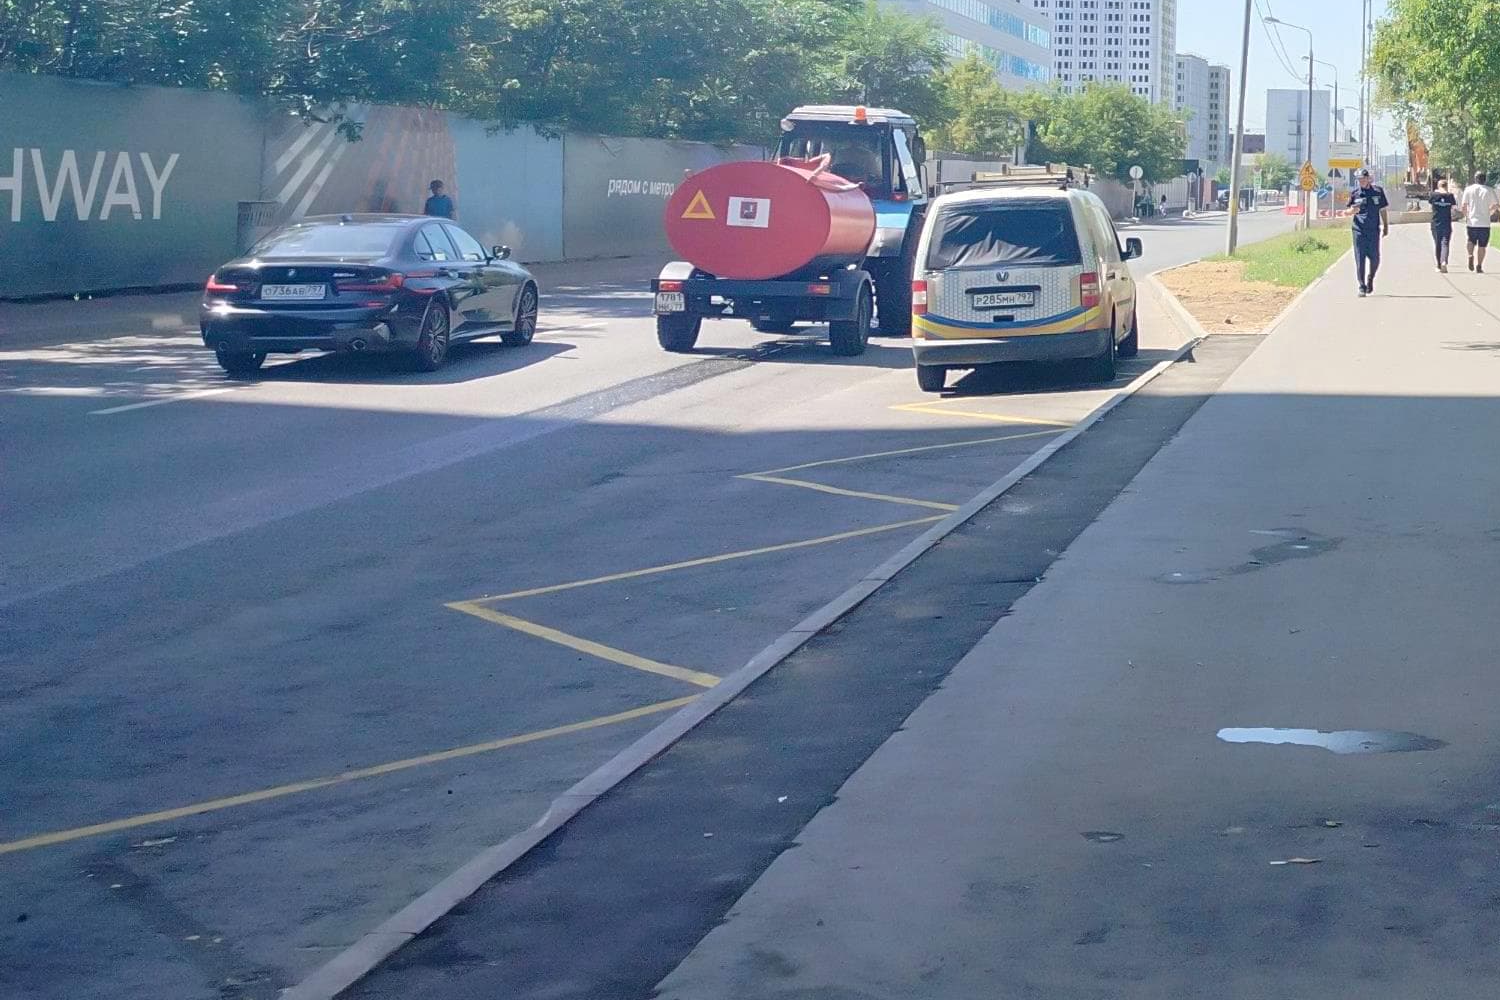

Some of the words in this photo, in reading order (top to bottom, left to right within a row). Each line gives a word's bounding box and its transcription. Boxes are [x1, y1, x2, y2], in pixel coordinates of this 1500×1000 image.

[607, 179, 641, 198] рядом
[642, 181, 649, 194] с
[649, 181, 675, 200] метро
